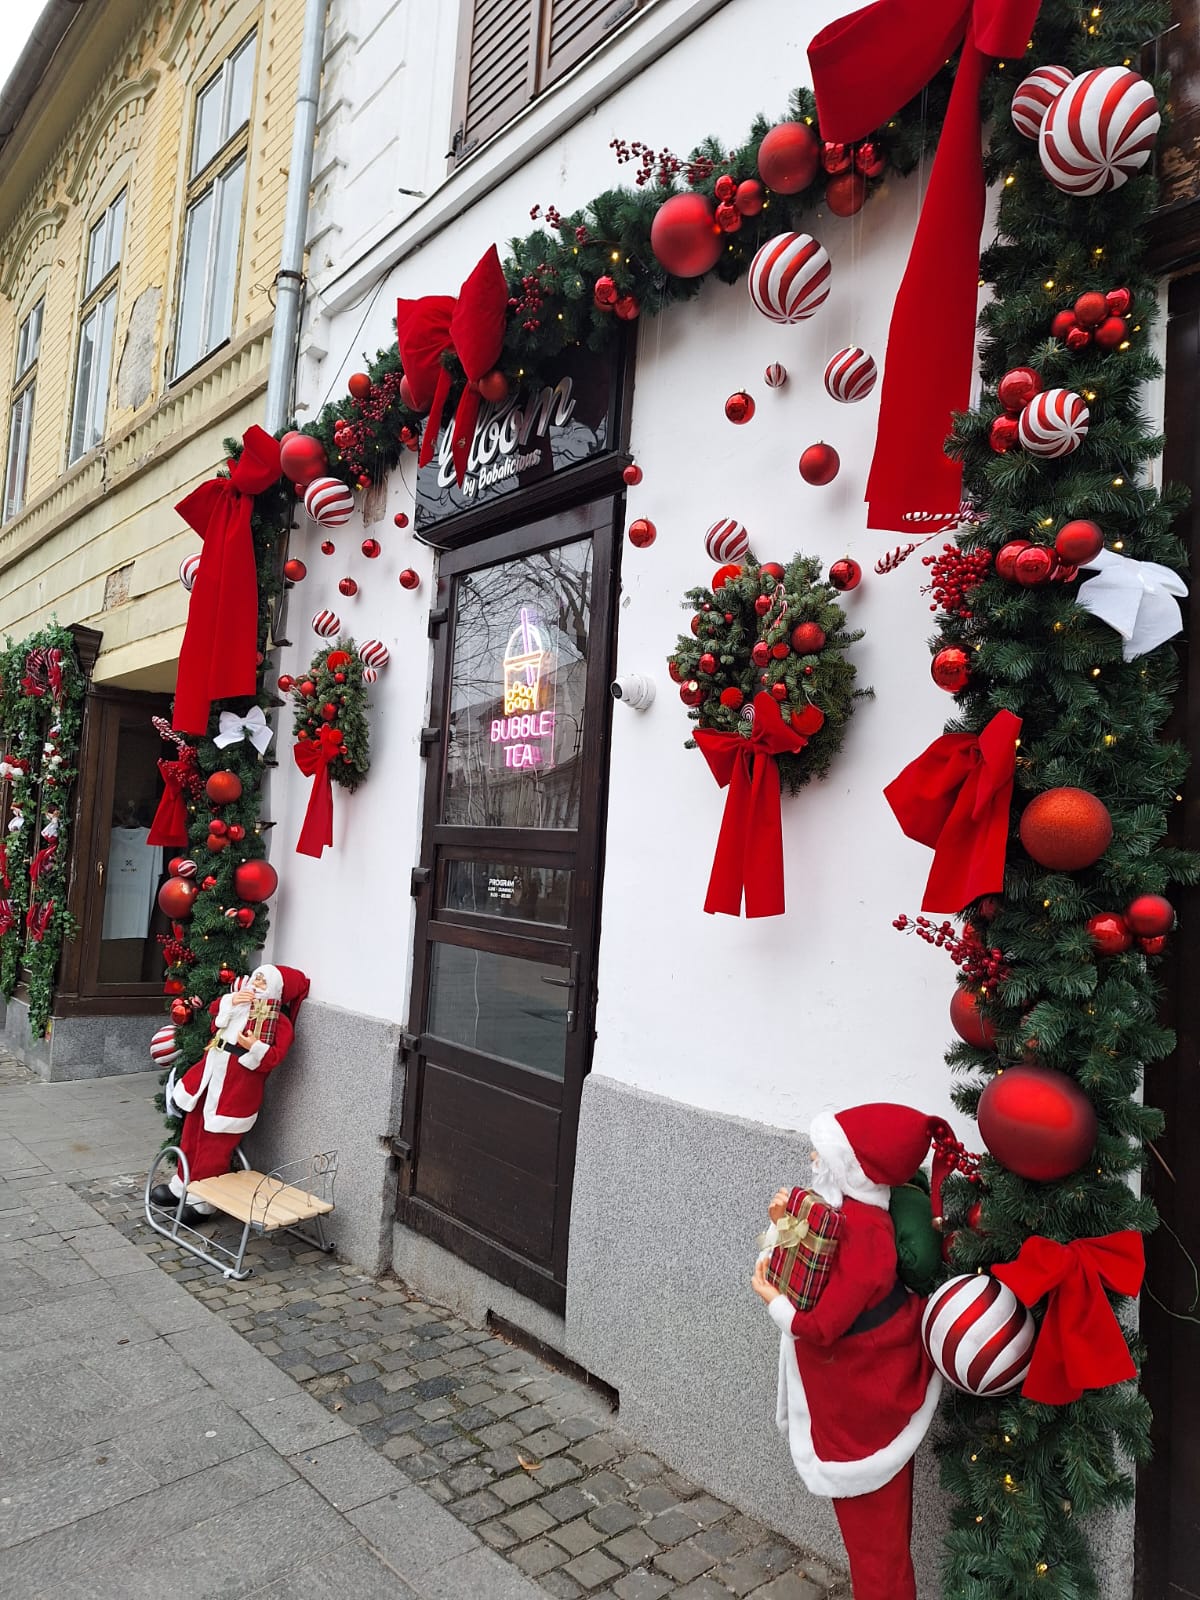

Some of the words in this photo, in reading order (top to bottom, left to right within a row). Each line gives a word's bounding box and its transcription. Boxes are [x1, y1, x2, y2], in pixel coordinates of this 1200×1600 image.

[462, 473, 477, 498] by
[478, 448, 542, 490] Bobalicious
[490, 710, 553, 743] BUBBLE
[503, 743, 535, 768] TEA
[488, 878, 515, 887] PROGRAM
